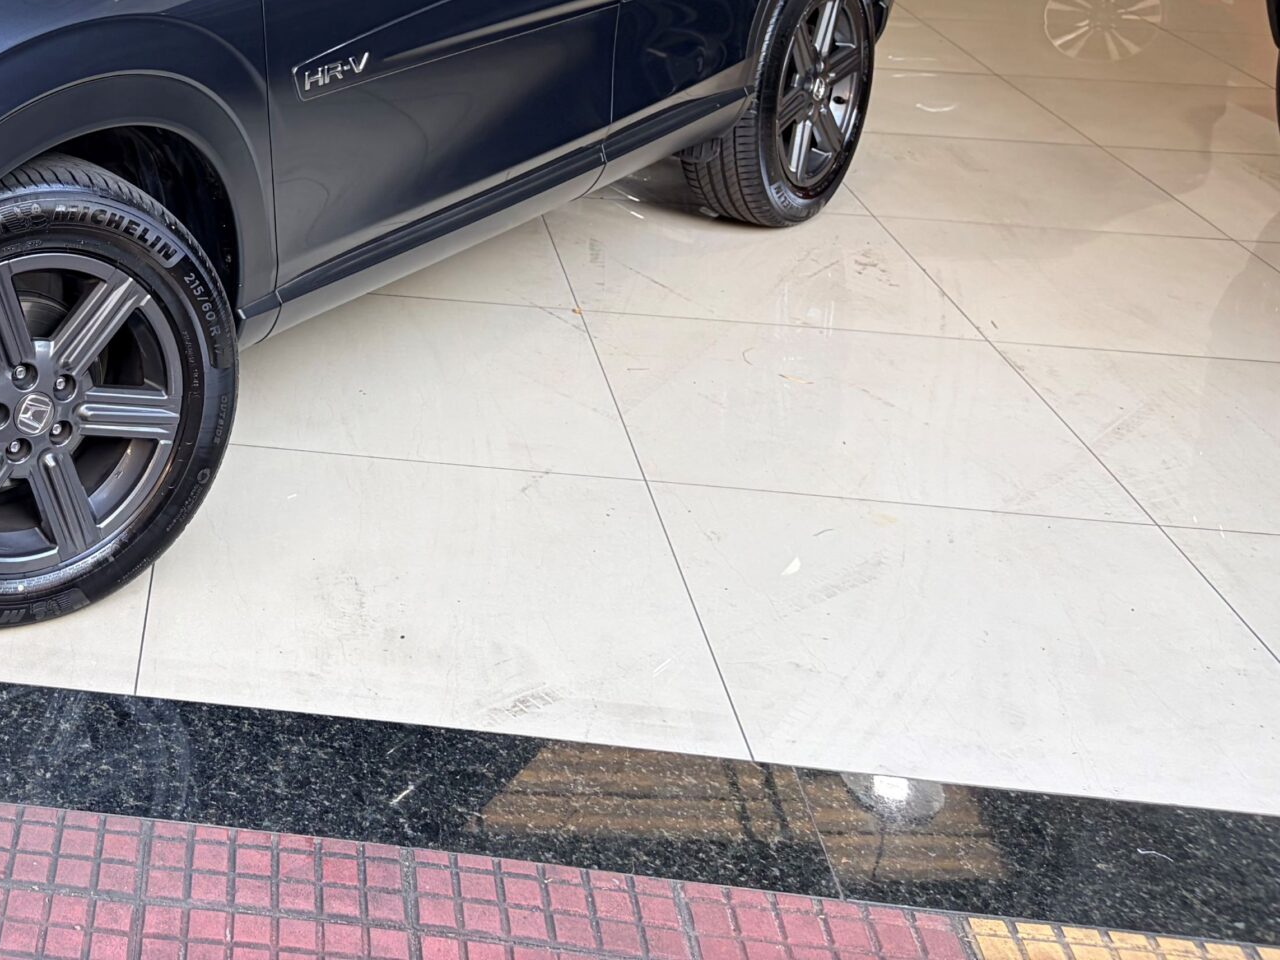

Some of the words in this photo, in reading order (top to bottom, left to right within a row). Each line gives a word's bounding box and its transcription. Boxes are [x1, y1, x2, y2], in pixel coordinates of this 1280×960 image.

[304, 51, 370, 91] HR-V
[52, 204, 179, 262] MICHELIN
[183, 272, 216, 321] 215/60
[209, 326, 221, 337] R
